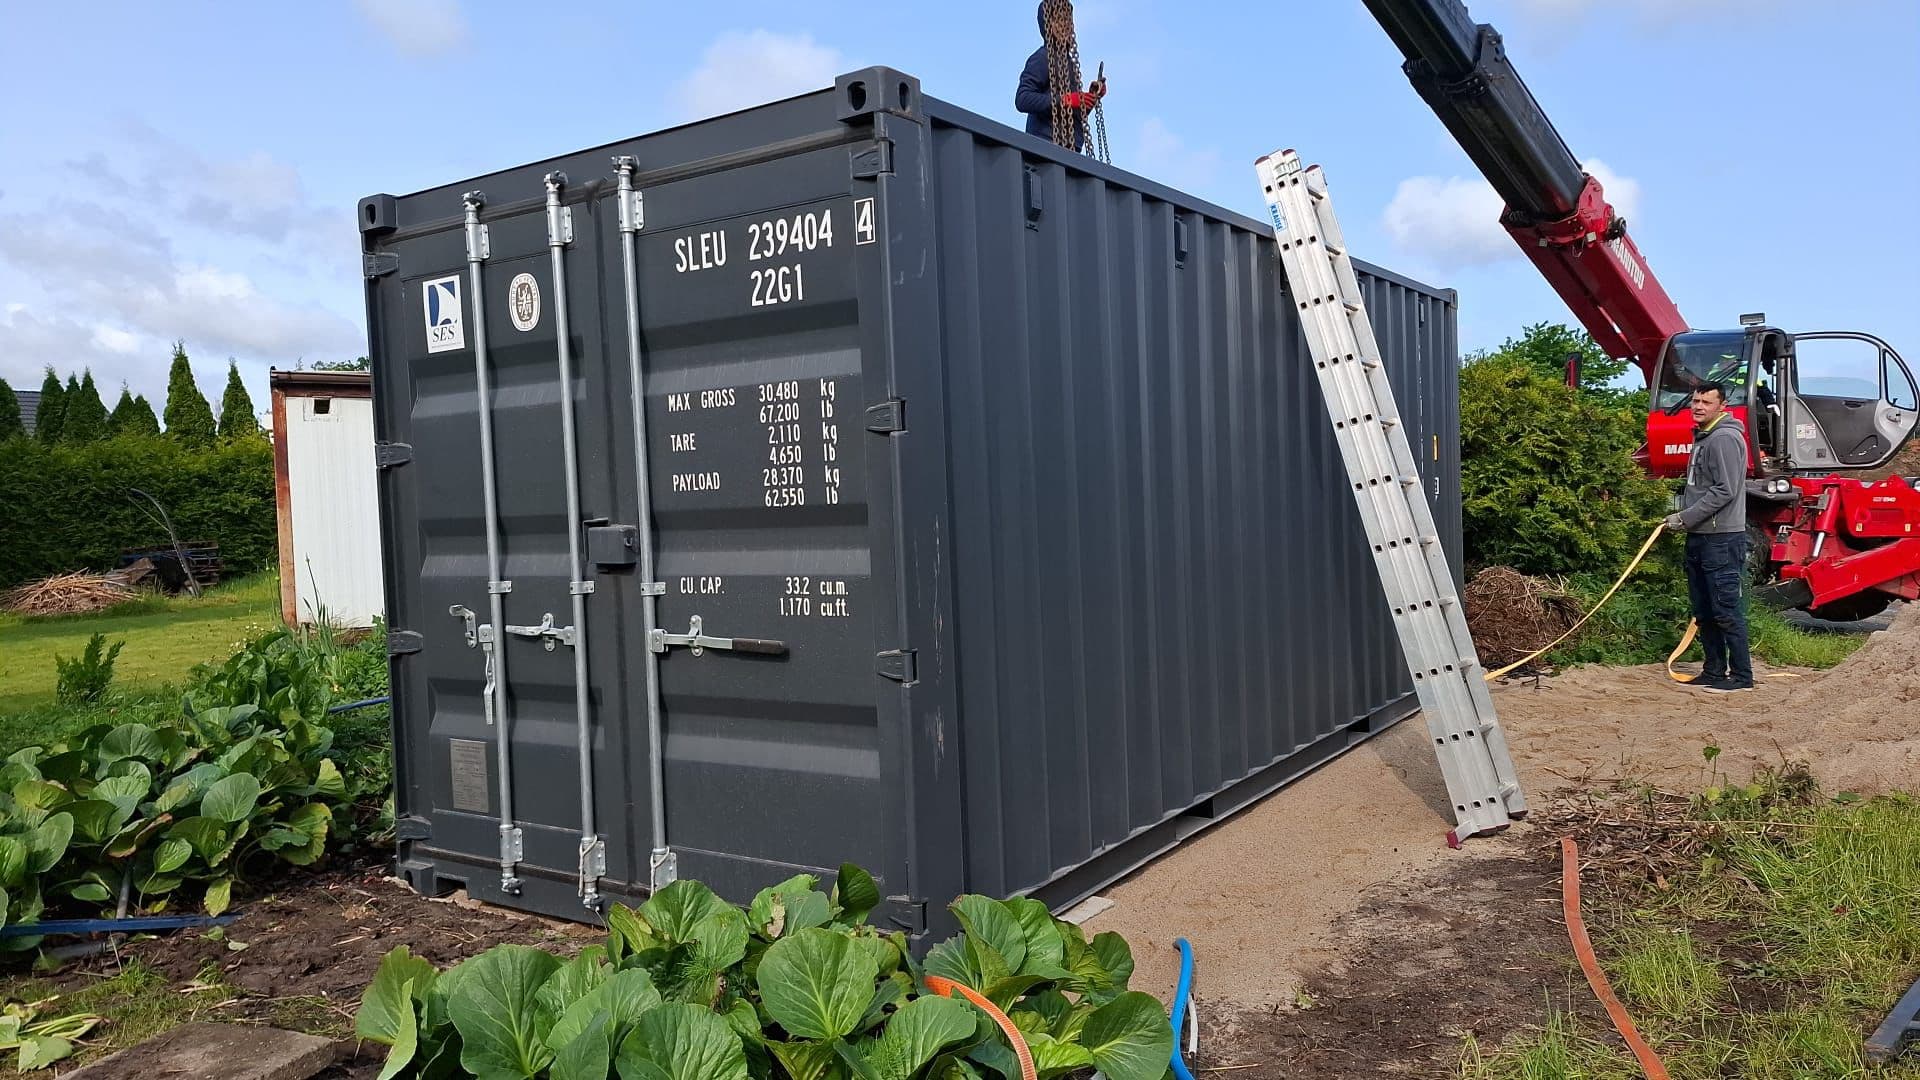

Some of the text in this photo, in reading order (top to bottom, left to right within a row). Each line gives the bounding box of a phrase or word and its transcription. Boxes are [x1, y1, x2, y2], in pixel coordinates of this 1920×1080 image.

[674, 200, 873, 273] SLEU 239404 4
[750, 263, 804, 307] 22G1
[432, 325, 456, 343] SES
[668, 392, 691, 412] MAX
[701, 388, 736, 409] GROSS
[820, 378, 835, 402] kg
[821, 399, 833, 418] lb
[670, 433, 696, 452] TARE
[822, 421, 838, 445] kg
[823, 443, 836, 462] lb
[672, 472, 721, 492] PAYLOAD
[824, 464, 840, 489] kg
[826, 486, 839, 505] lb
[680, 576, 849, 596] CU. CAP. 33.2 cu.m.
[820, 598, 850, 617] cu.ft.
